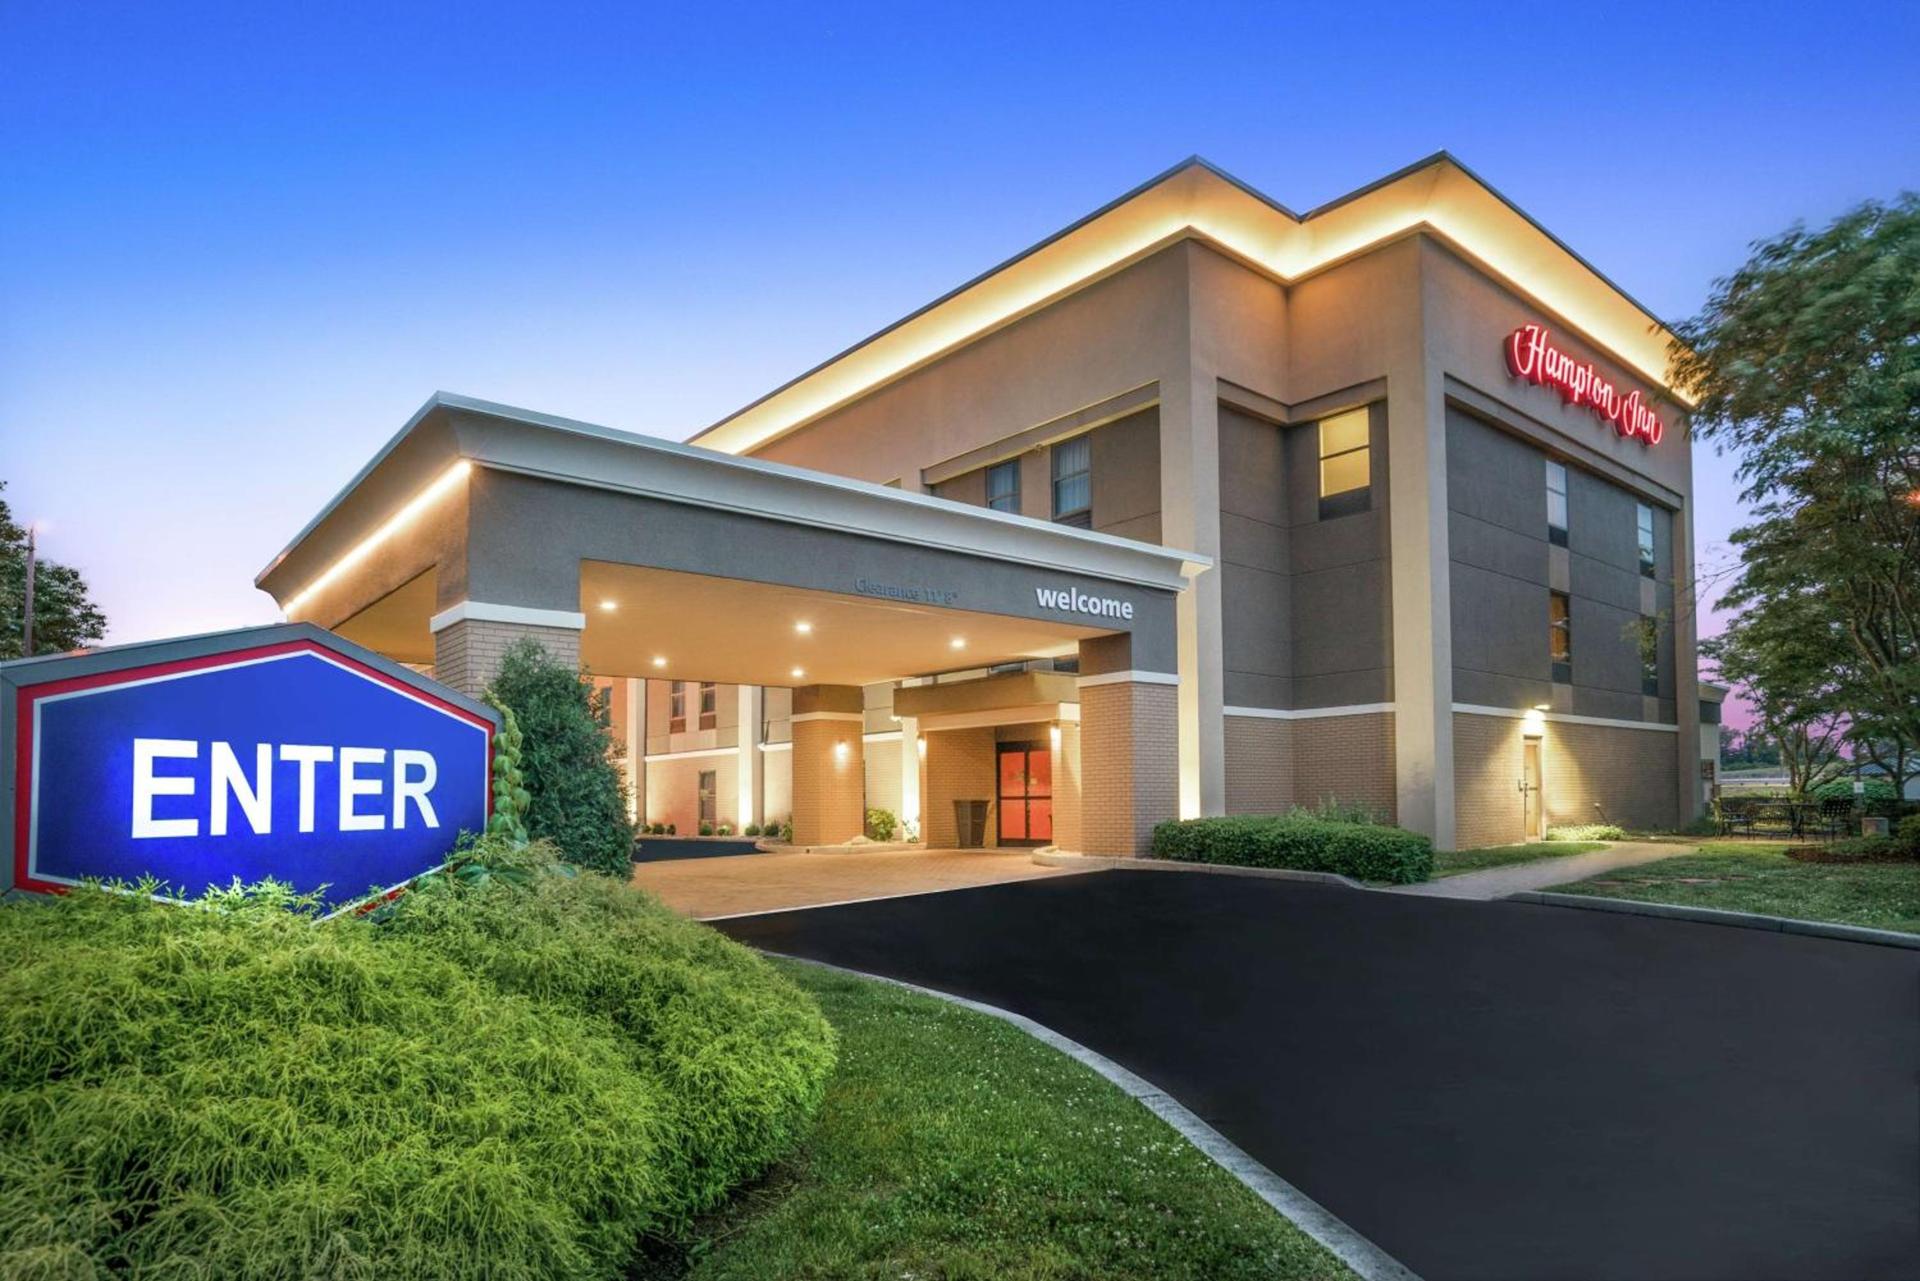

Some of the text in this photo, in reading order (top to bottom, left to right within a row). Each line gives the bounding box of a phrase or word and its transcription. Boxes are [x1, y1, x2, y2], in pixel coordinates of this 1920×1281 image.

[1514, 325, 1662, 444] Hampton Inn
[854, 577, 921, 601] Clearance
[1036, 587, 1133, 619] welcome
[132, 738, 440, 839] ENTER
